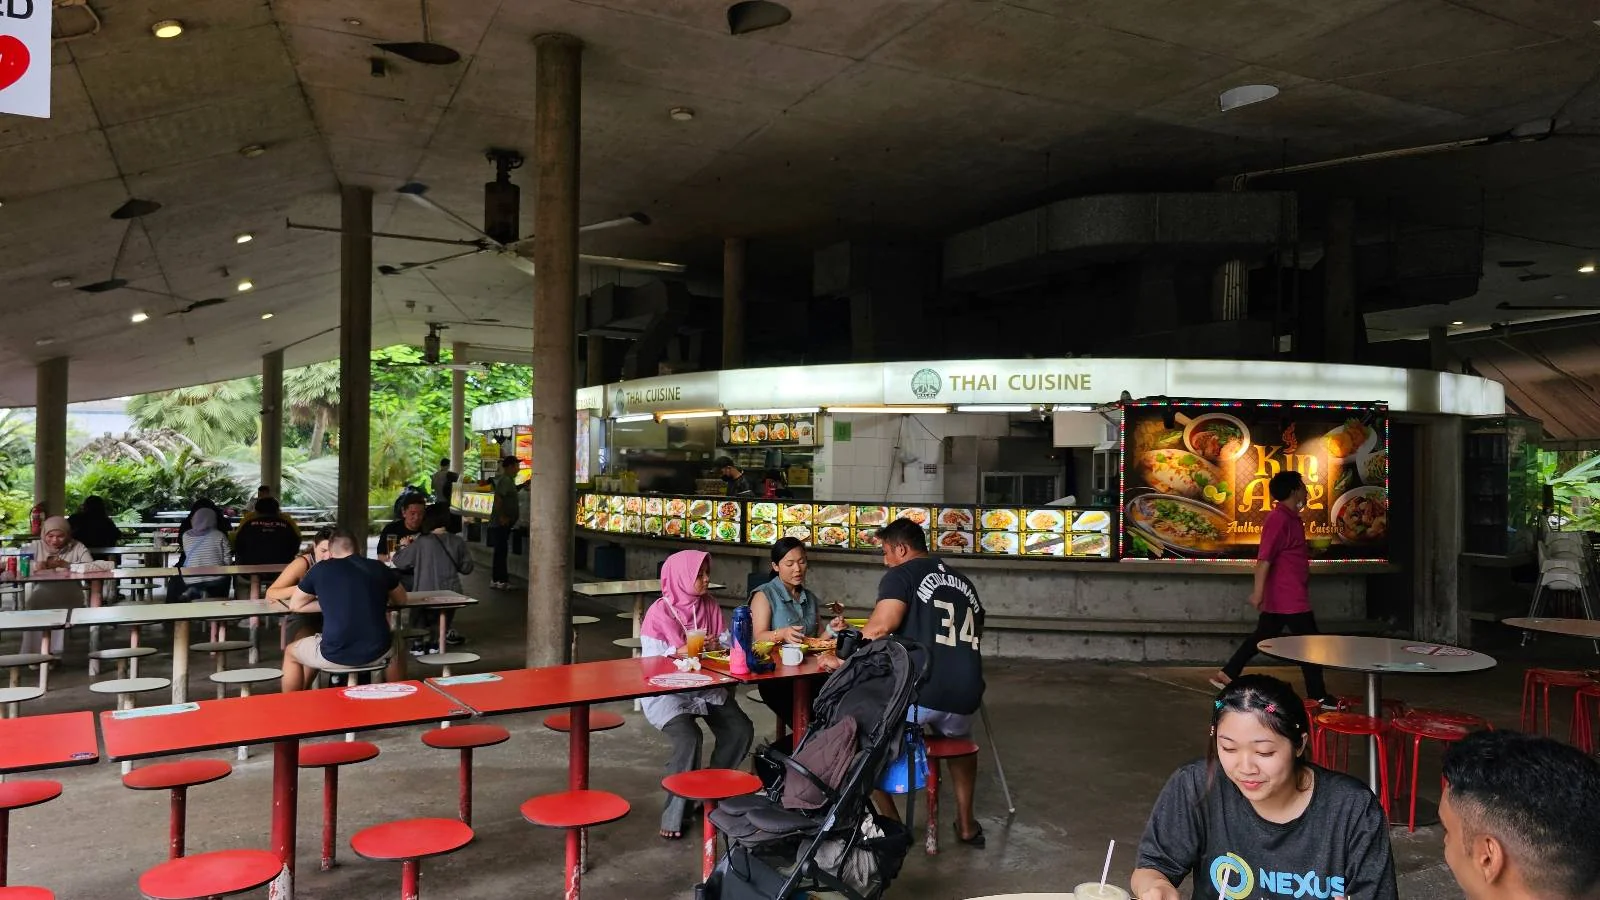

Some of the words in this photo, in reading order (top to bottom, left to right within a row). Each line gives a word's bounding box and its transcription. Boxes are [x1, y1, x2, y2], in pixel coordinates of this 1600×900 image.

[0, 0, 34, 19] D
[949, 374, 997, 391] THAI
[1007, 374, 1092, 391] CUISINE
[626, 390, 642, 405] THAI
[645, 387, 681, 403] CUISINE
[1253, 444, 1319, 482] Kin
[1309, 520, 1344, 534] Cuisine
[933, 599, 979, 651] 34
[1259, 867, 1345, 899] NEXUS
